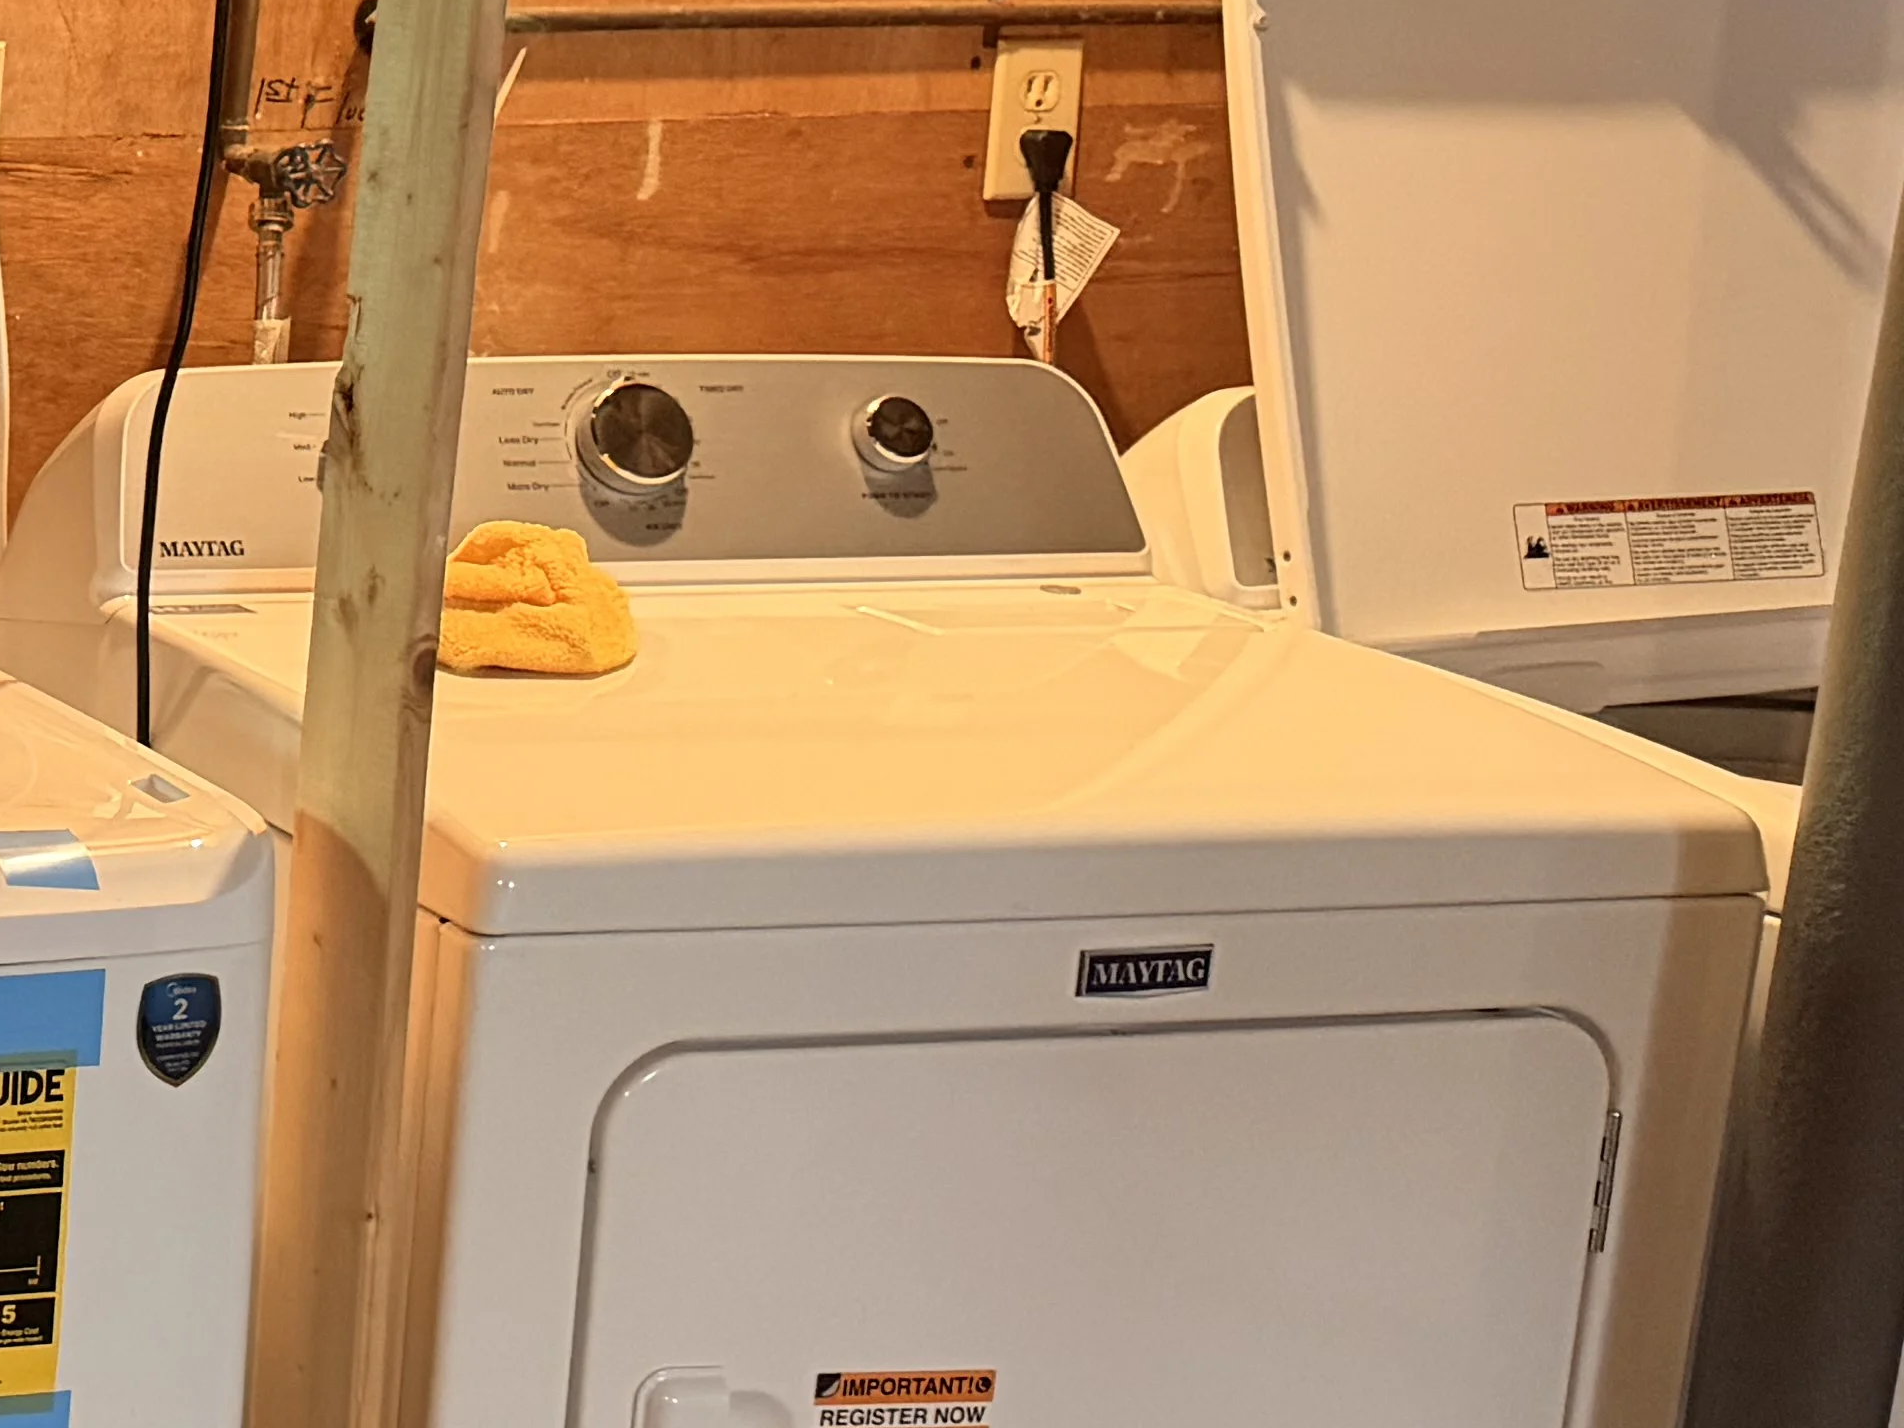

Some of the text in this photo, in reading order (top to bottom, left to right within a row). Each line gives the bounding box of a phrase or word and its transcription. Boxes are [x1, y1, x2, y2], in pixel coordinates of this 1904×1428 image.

[159, 539, 245, 558] MAYTAG
[1093, 957, 1205, 985] MAYTAG
[172, 997, 189, 1021] 2
[842, 1376, 974, 1397] IMPORTANT!
[820, 1406, 986, 1427] REGISTER NOW
